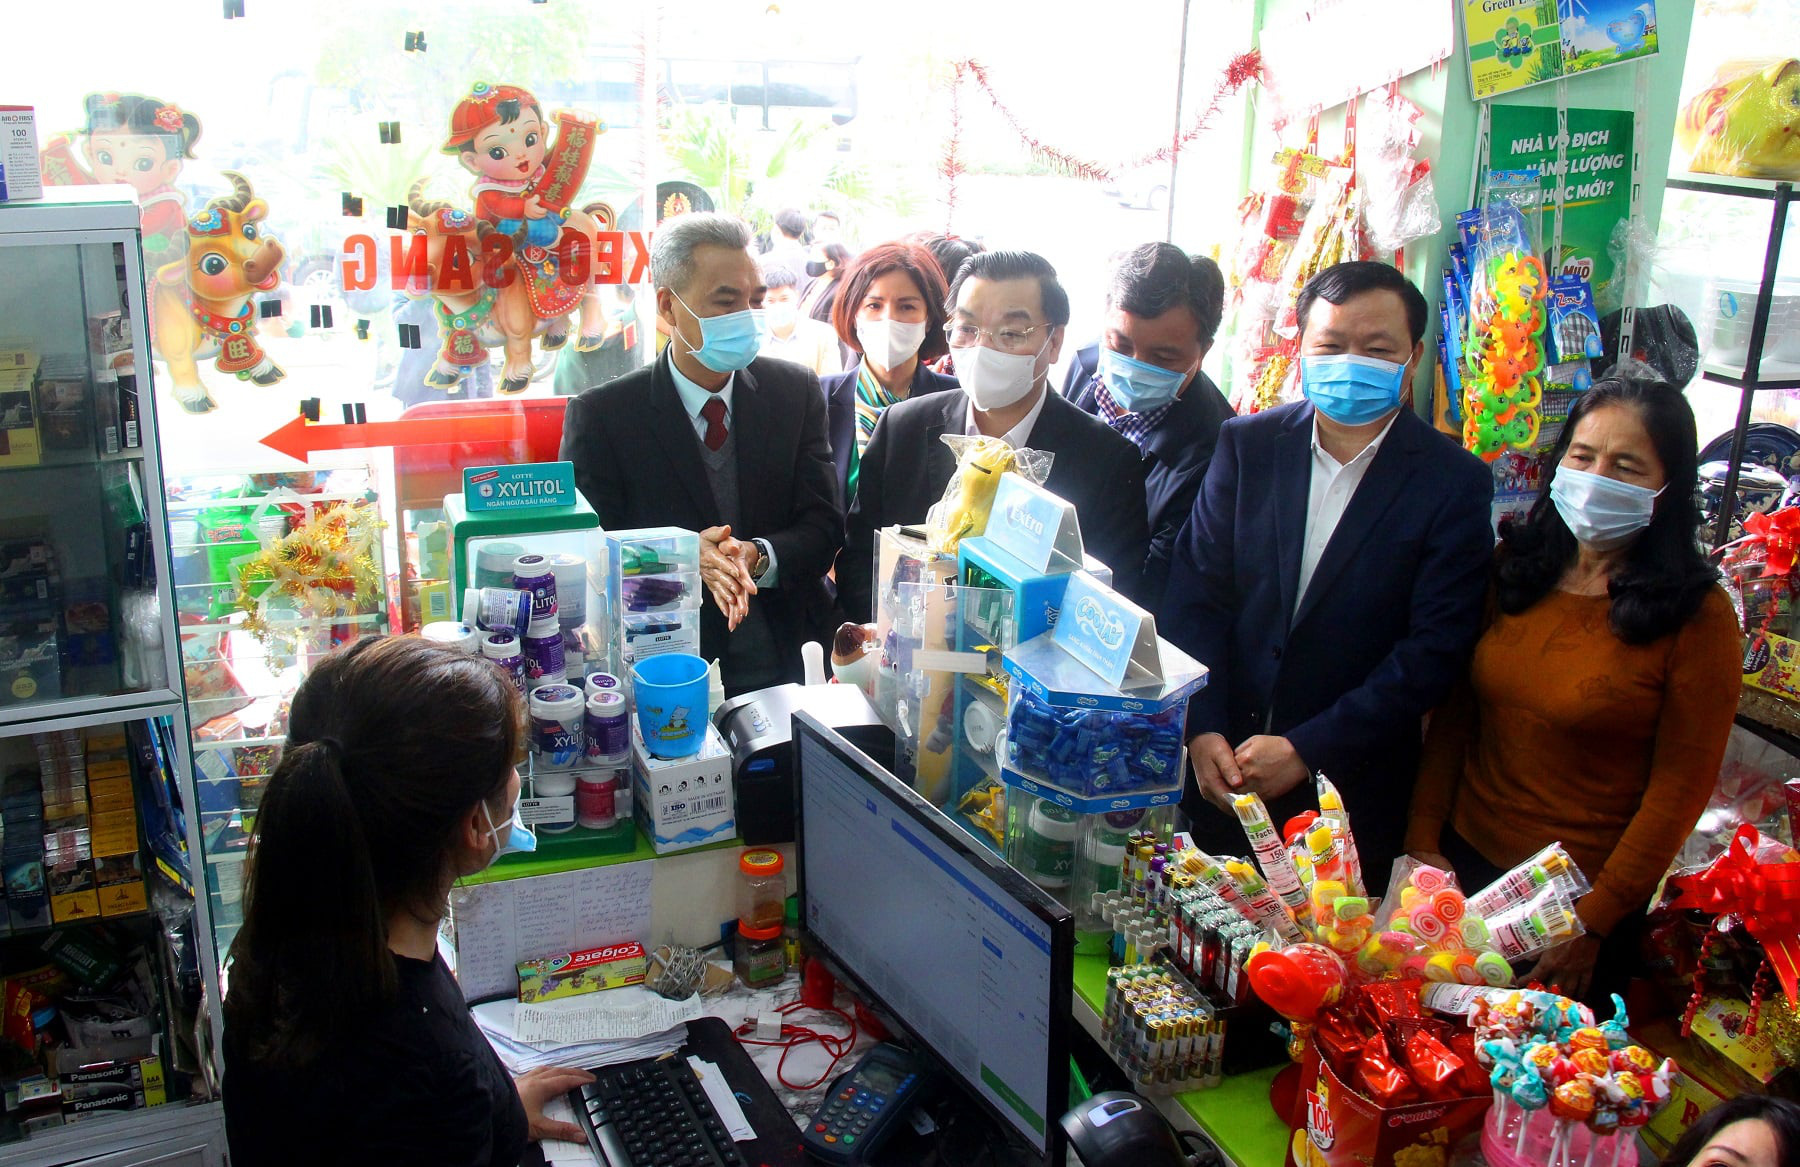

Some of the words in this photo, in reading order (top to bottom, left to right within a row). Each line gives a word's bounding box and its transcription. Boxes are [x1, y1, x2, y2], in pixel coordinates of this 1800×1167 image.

[1482, 0, 1515, 13] Green
[12, 129, 27, 137] 100
[1511, 132, 1543, 154] NHÀ
[1572, 130, 1610, 152] ĐỊCH
[1571, 153, 1625, 176] LƯỢNG
[1576, 178, 1615, 200] MỚI?
[227, 338, 250, 360] 旺
[454, 335, 475, 355] 福
[497, 479, 565, 498] XYLITOL
[1010, 505, 1044, 535] Extra
[670, 803, 686, 811] ISO
[1255, 828, 1274, 840] Facts
[1269, 848, 1285, 860] 150
[1264, 902, 1281, 913] 150
[1527, 924, 1543, 947] Facts
[575, 945, 639, 963] Colgate
[1507, 941, 1522, 957] 150
[70, 1067, 125, 1082] Panasonic
[146, 1076, 160, 1084] AAA
[75, 1093, 129, 1111] Panasonic
